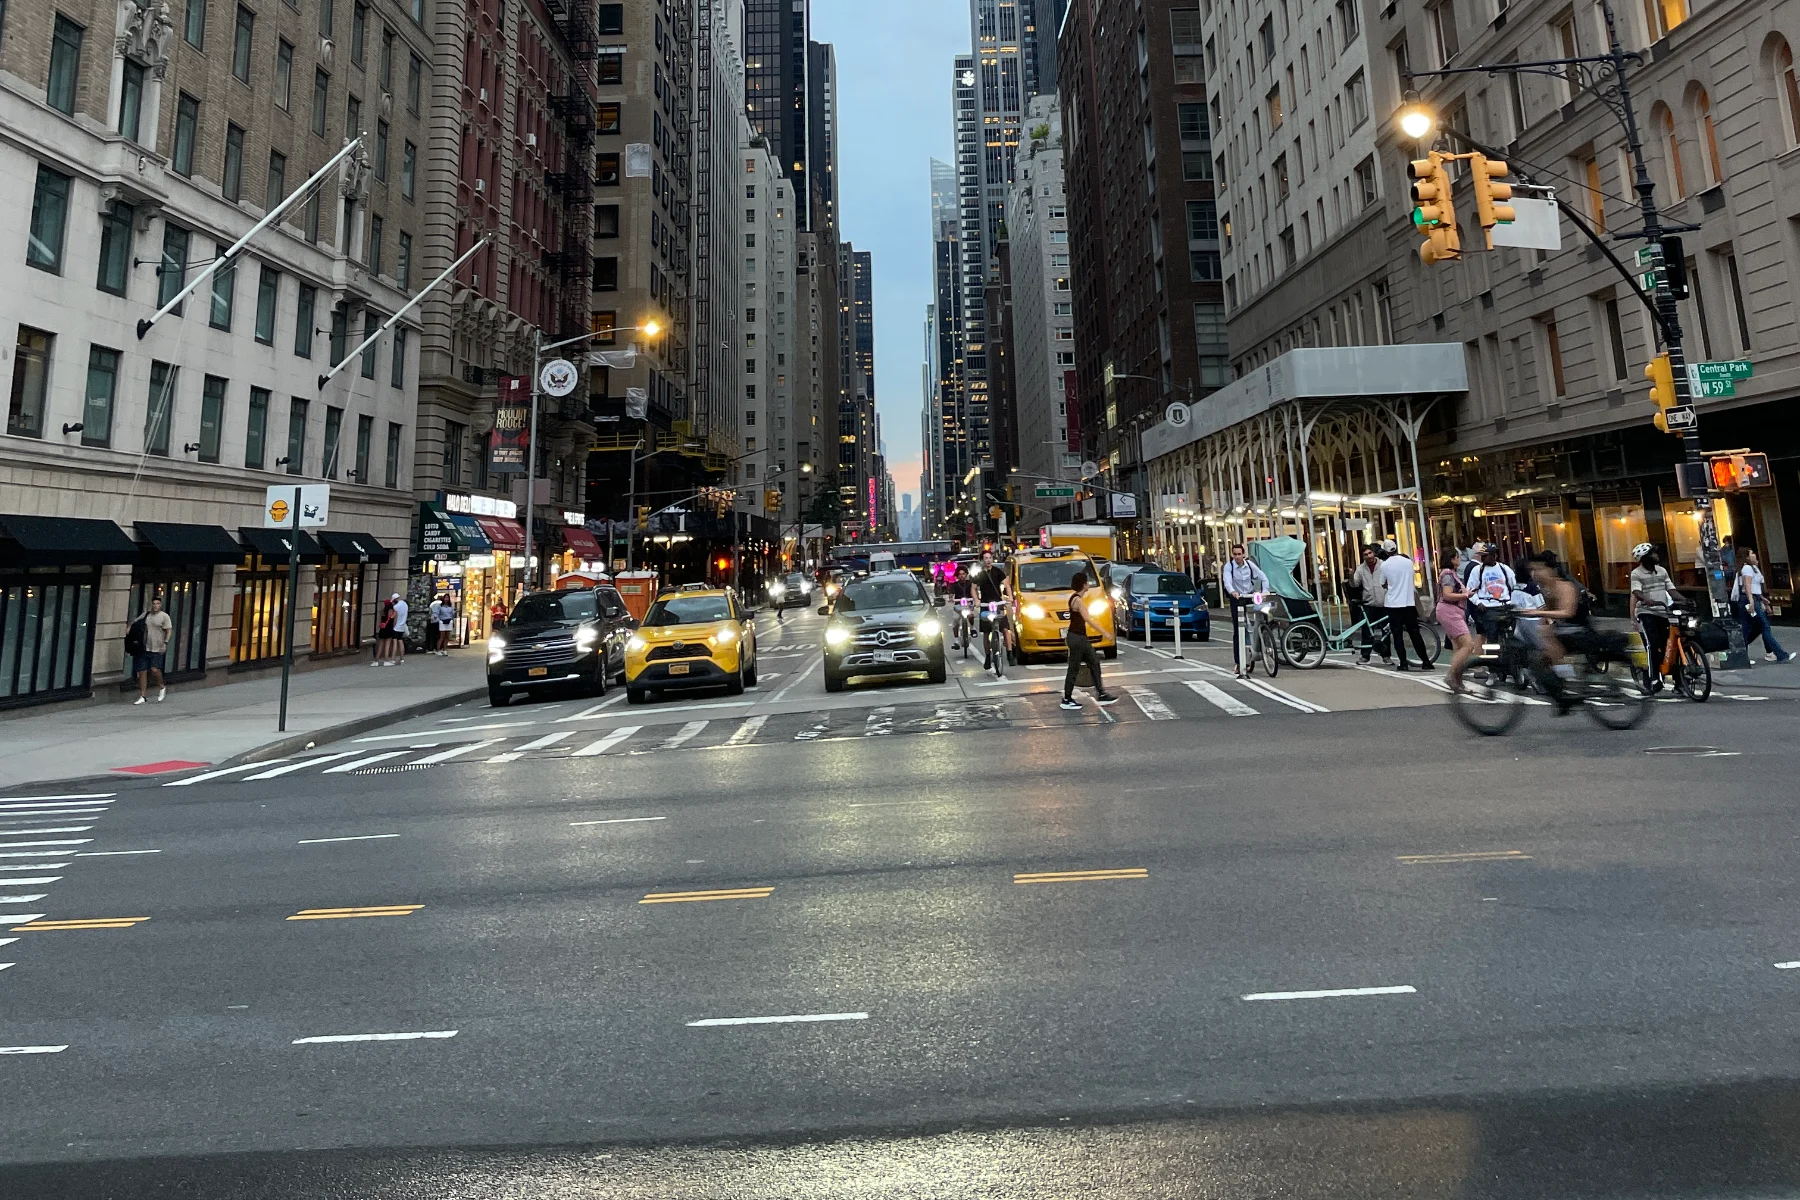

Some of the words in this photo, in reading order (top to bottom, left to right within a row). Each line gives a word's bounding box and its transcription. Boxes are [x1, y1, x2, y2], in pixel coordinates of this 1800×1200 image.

[1700, 363, 1727, 374] Central
[1729, 362, 1748, 372] Park
[1701, 381, 1710, 395] W
[1712, 381, 1724, 395] 59
[1668, 414, 1678, 423] ONE
[1681, 412, 1692, 421] WAY
